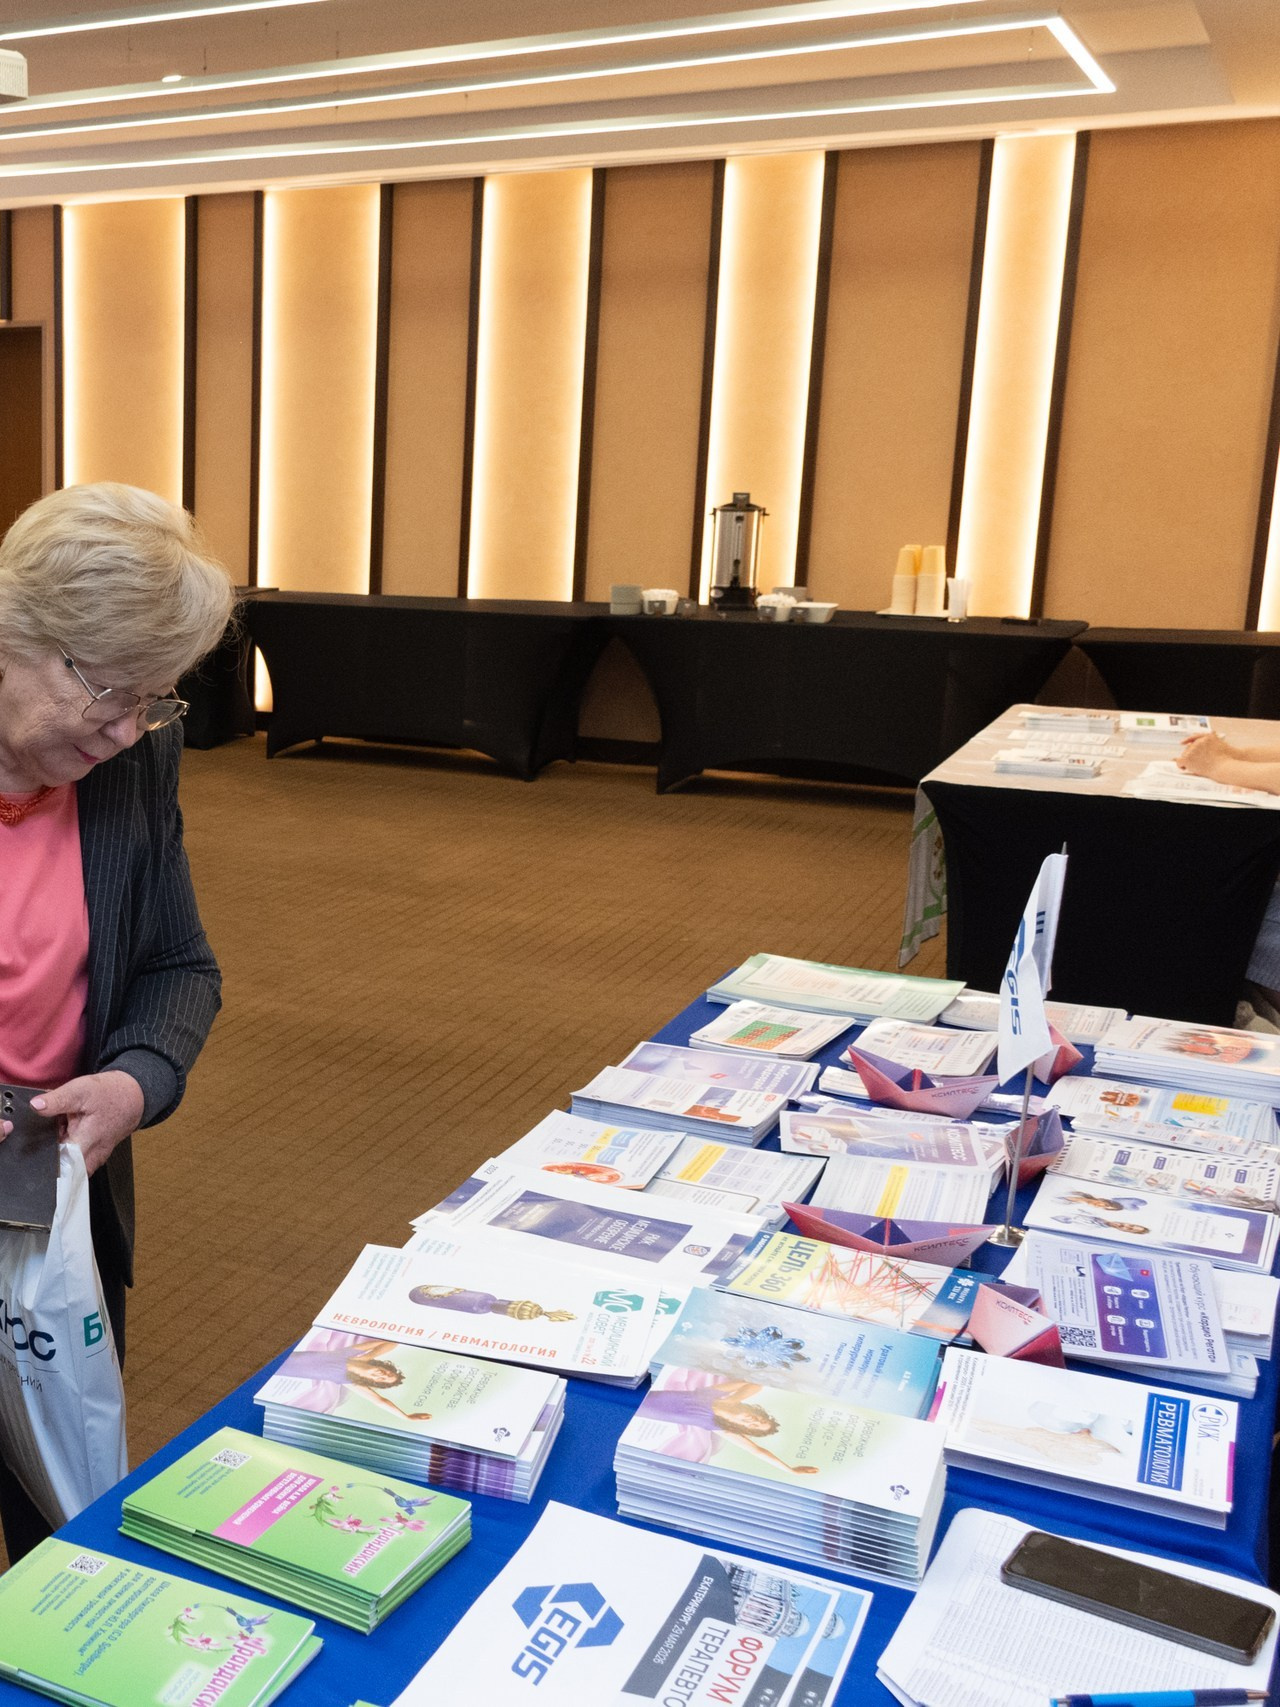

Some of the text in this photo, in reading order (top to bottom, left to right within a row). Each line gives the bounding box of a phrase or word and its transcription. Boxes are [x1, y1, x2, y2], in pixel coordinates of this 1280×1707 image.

[778, 1240, 818, 1273] ЦЕЛЬ
[760, 1273, 792, 1293] 360
[332, 1312, 425, 1339] НЕВРОЛОГИЯ
[442, 1332, 558, 1360] РЕВМАТОЛОГИЯ
[413, 1362, 448, 1407] нарушения сна
[442, 1369, 462, 1390] фокусе
[466, 1372, 497, 1404] Тревожные
[795, 1408, 824, 1459] нарушения сна
[822, 1414, 842, 1440] фокусе
[853, 1420, 879, 1457] Тревожные
[1151, 1402, 1176, 1484] РЕВМАТОЛОГИЯ
[1198, 1415, 1220, 1441] РМЖ
[233, 1472, 296, 1525] ВЕГЕТАТИВНЫХ ИЗМЕНЕНИЙ
[272, 1475, 305, 1499] ДЛЯ ОЦЕНКИ
[298, 1479, 315, 1492] ШКАЛА
[272, 1500, 290, 1514] ВЕЙНА
[346, 1528, 400, 1573] Грандаксин
[85, 1572, 143, 1628] для оценки личностной
[97, 1572, 127, 1599] реактивной
[115, 1577, 156, 1615] адаптированная
[150, 1581, 170, 1597] Шкала
[64, 1600, 98, 1632] тревожности
[118, 1597, 154, 1629] Спилбергера
[511, 1607, 582, 1686] EGIS
[653, 1646, 669, 1665] 2026
[666, 1631, 680, 1648] МАЯ
[705, 1636, 764, 1706] ФОРУМ
